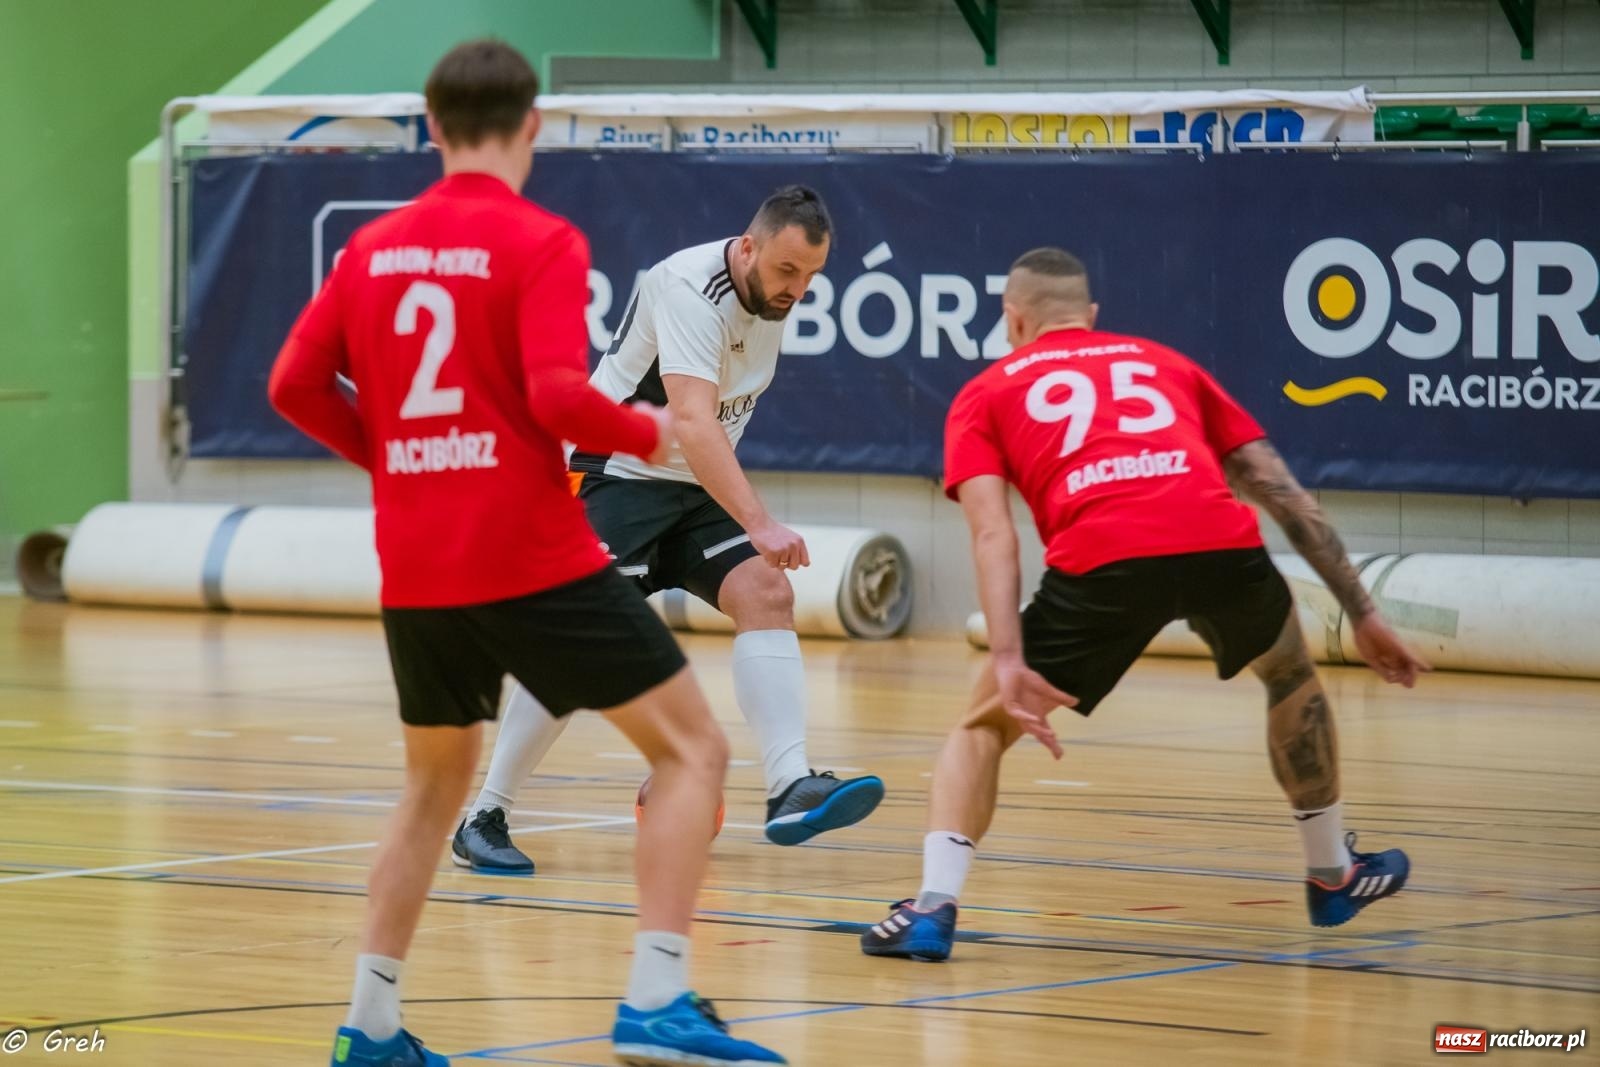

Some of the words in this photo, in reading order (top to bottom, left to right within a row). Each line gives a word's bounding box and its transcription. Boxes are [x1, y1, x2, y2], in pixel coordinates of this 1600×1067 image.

[1282, 237, 1600, 363] OSiR
[394, 280, 464, 420] 2
[1408, 365, 1600, 411] RACIBÓRZ
[1025, 361, 1177, 458] 95
[1066, 449, 1191, 496] RACIBÓRZ
